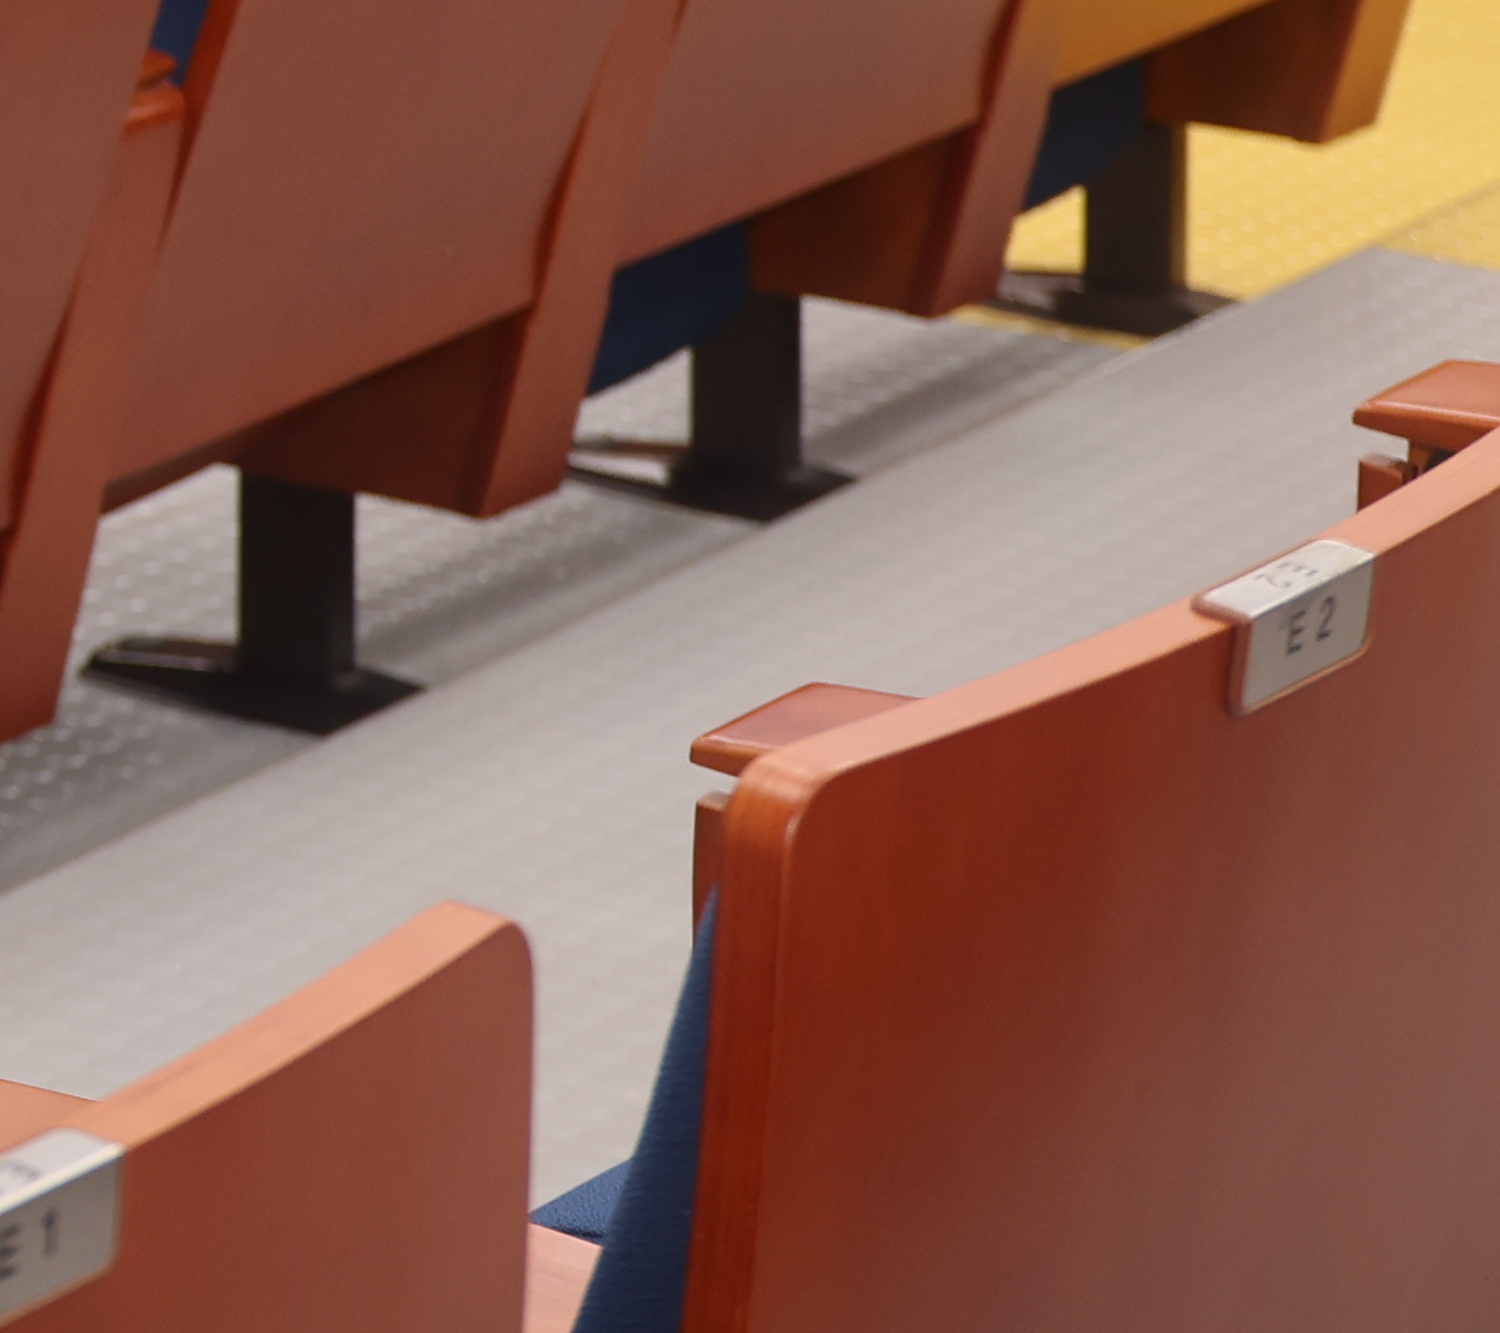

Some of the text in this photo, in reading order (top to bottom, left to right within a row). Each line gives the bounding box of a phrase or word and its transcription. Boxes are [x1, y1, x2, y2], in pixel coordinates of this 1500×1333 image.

[1285, 595, 1336, 656] E 2
[40, 1205, 59, 1258] 1
